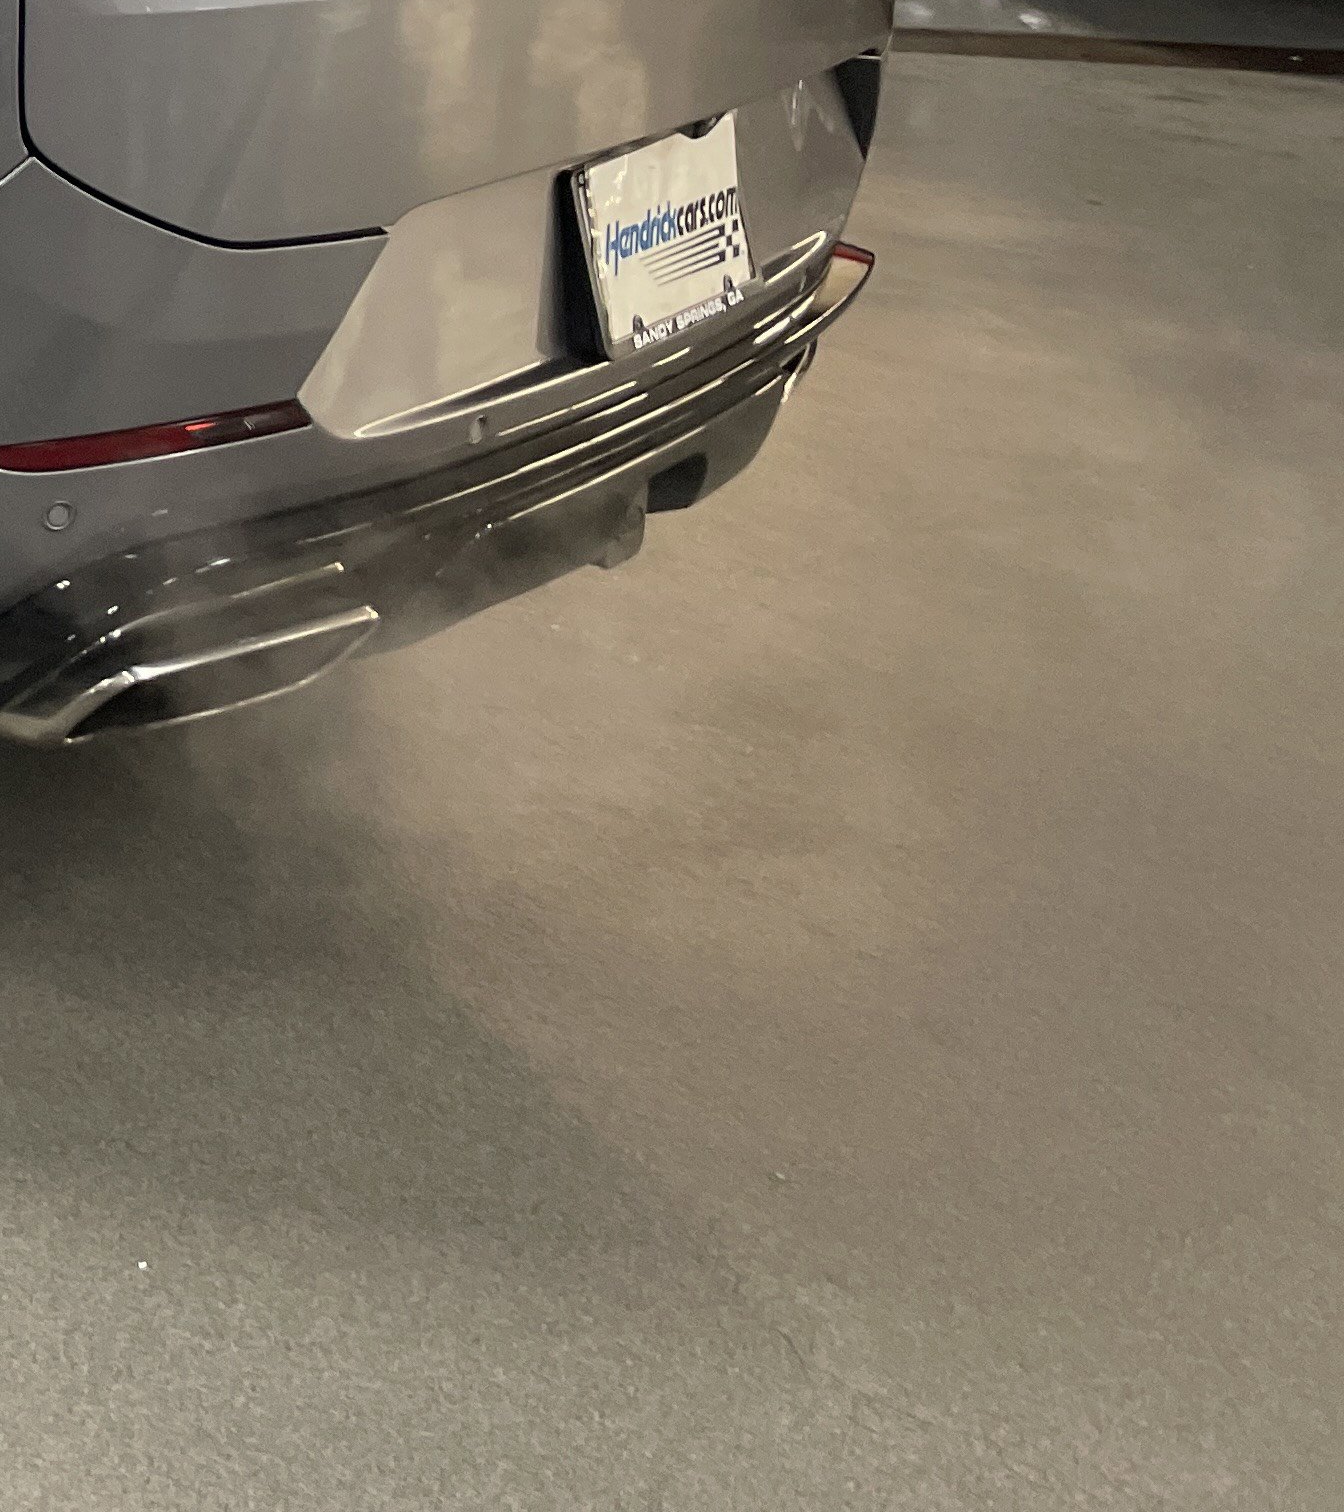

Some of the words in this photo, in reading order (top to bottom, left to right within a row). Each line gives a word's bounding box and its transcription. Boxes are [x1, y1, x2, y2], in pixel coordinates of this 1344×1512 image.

[606, 186, 738, 277] Hendrickcars.com
[632, 318, 674, 349] SANDY
[726, 288, 745, 307] GA
